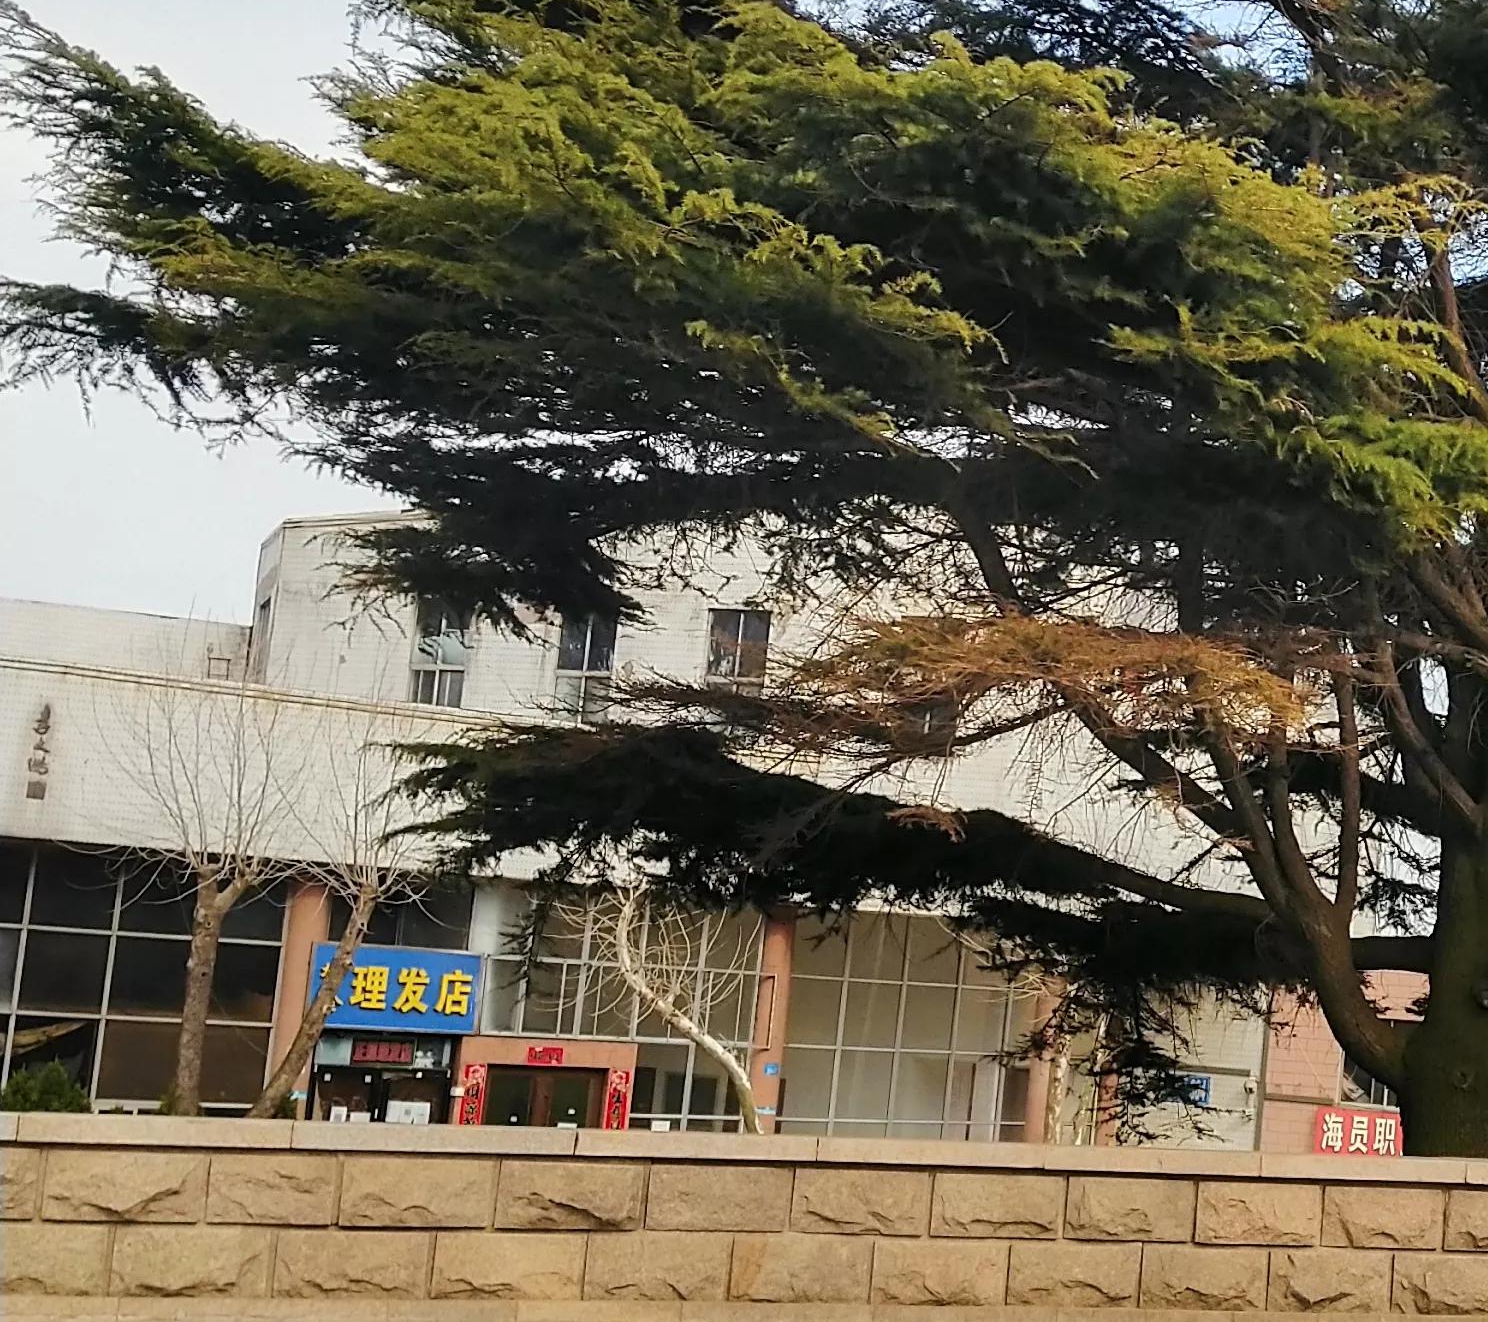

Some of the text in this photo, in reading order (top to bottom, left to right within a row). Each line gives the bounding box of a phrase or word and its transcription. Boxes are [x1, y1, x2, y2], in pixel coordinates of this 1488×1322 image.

[320, 963, 474, 1016] 理发店
[1321, 1112, 1404, 1157] 海员职
